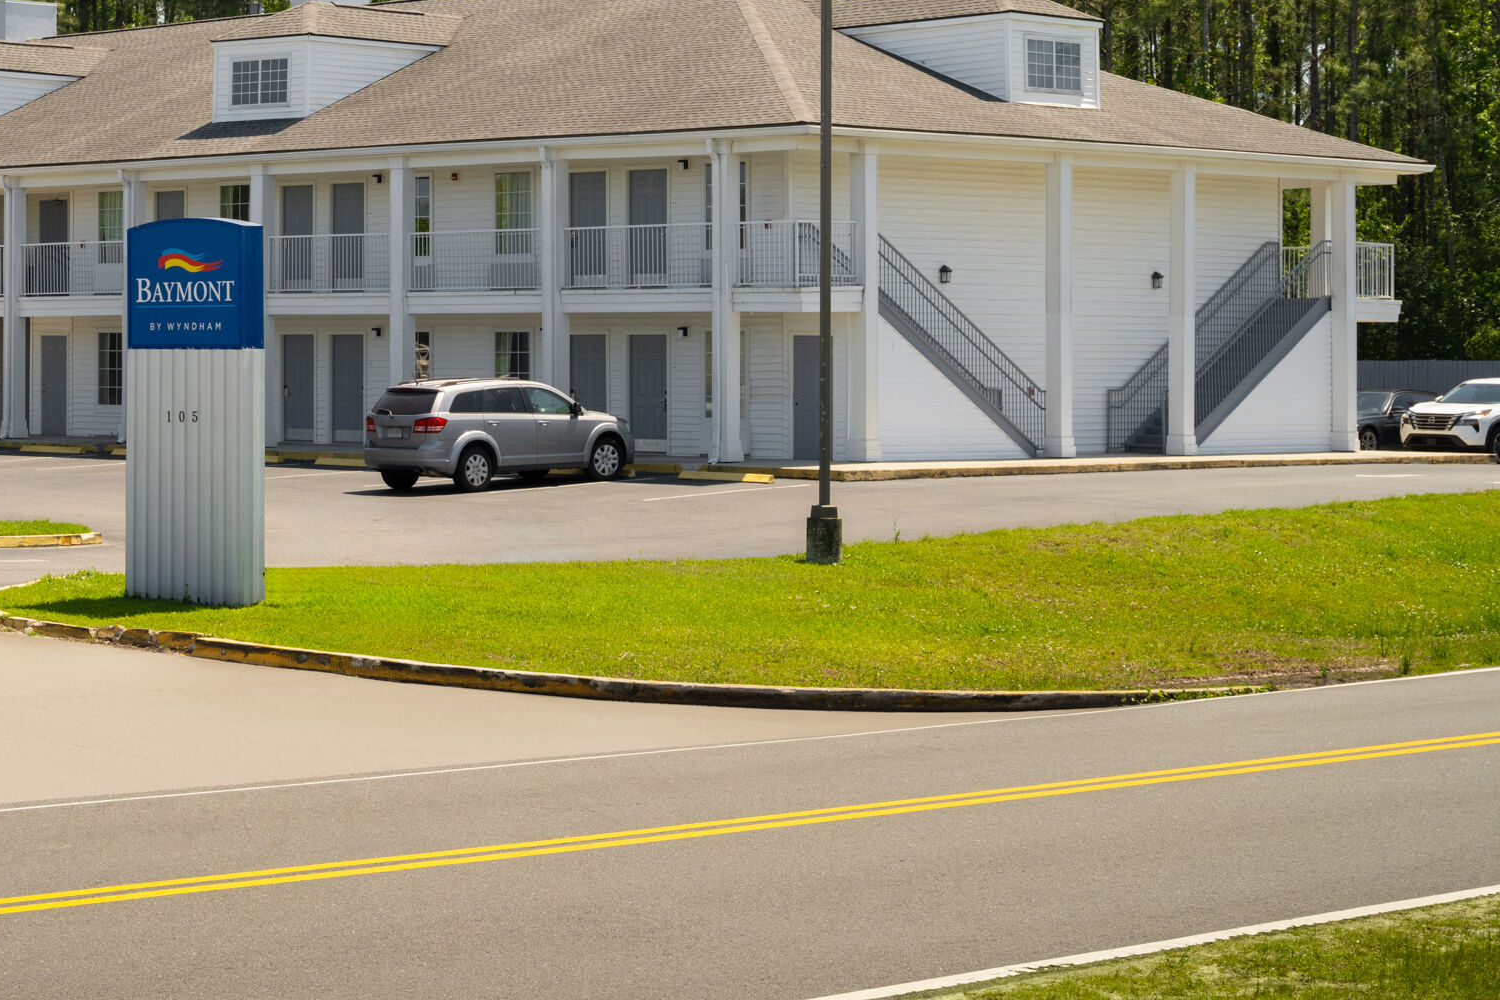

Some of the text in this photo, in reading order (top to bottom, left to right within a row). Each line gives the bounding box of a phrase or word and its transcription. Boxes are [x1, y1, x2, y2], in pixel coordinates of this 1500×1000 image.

[136, 278, 235, 303] BAYMONT
[150, 322, 222, 331] BY WYNDHAM
[167, 411, 198, 423] 105
